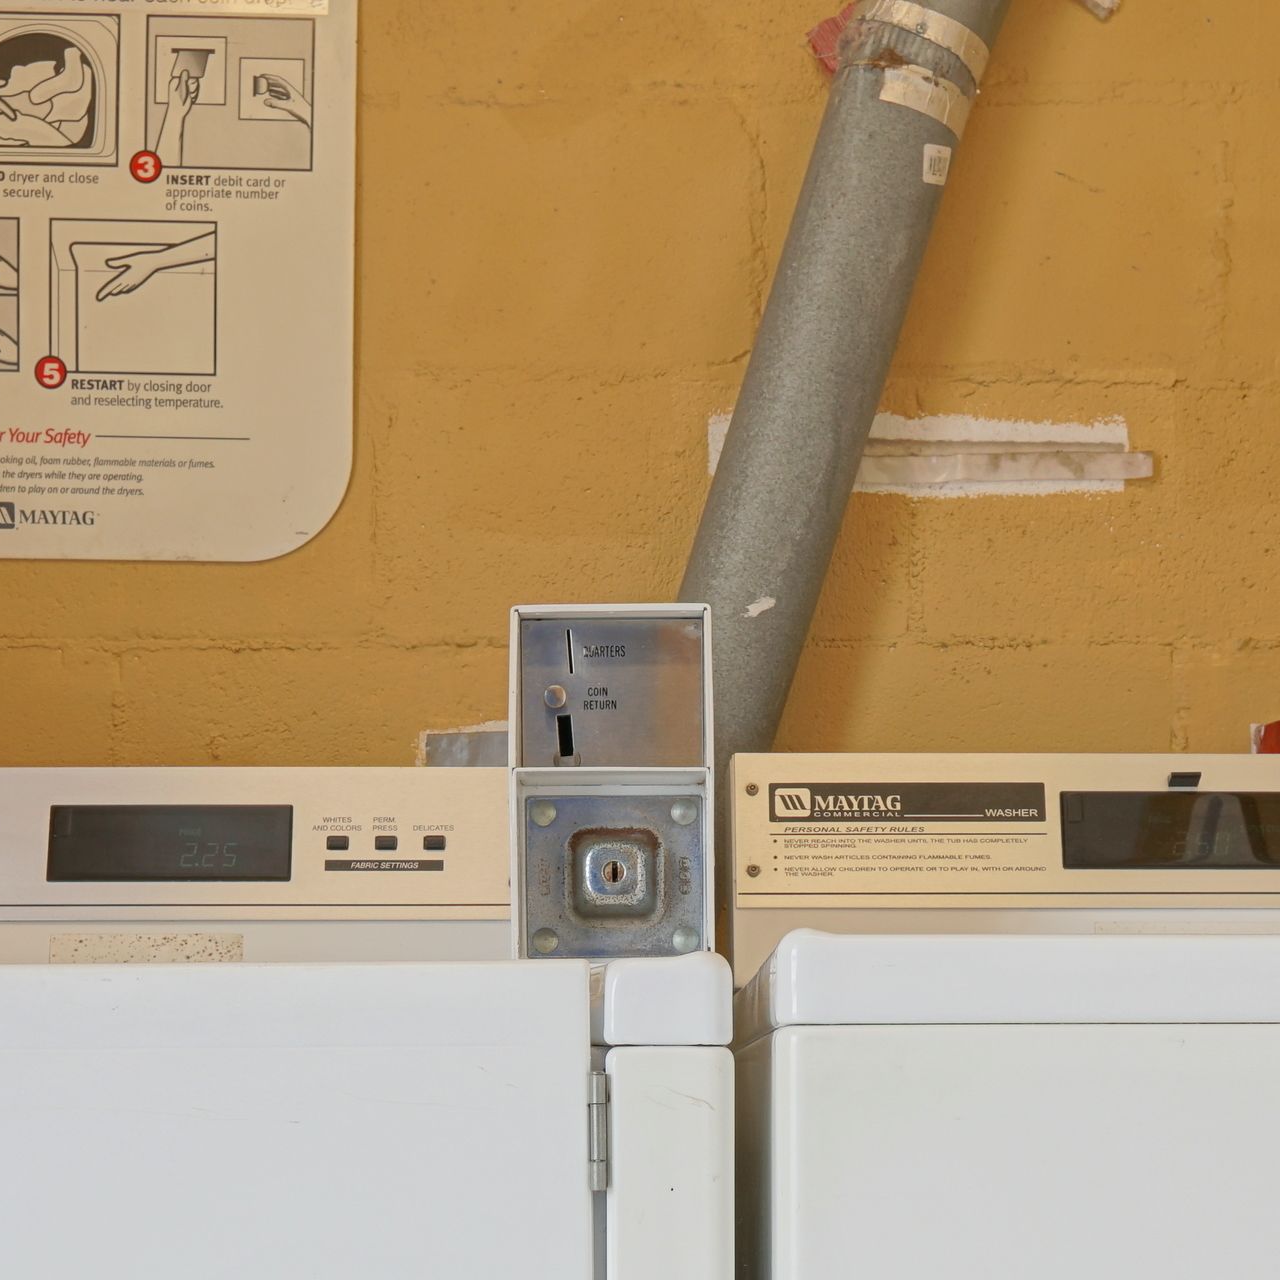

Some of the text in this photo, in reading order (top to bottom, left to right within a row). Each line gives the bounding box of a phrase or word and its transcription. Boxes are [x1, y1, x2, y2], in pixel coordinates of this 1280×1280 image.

[8, 171, 38, 185] dryer
[43, 172, 65, 183] and
[68, 172, 100, 184] close
[136, 156, 286, 188] 3 INSERT debit card or
[2, 186, 54, 200] securely.
[165, 188, 279, 202] appropriate number
[165, 200, 213, 212] of coins.
[42, 362, 211, 395] 5 RESTART by closing door
[70, 394, 224, 410] and reselecting temperature.
[8, 428, 42, 443] Your
[44, 428, 91, 449] Safety
[39, 456, 61, 466] foam
[93, 457, 137, 468] flammable
[138, 458, 176, 468] materials
[177, 460, 187, 468] or
[2, 469, 16, 478] the
[17, 470, 43, 480] dryers
[44, 471, 67, 480] while
[68, 472, 86, 482] they
[87, 473, 101, 481] are
[102, 472, 144, 483] operating.
[18, 484, 27, 493] to
[28, 485, 46, 495] play
[47, 486, 59, 494] on
[60, 486, 69, 494] or
[70, 486, 100, 495] around
[102, 486, 116, 495] the
[117, 486, 144, 497] dryers.
[19, 509, 95, 525] MAYTAG
[587, 687, 608, 697] COIN
[583, 700, 617, 711] RETURN
[814, 795, 901, 811] MAYTAG
[985, 809, 1038, 817] WASHER
[179, 842, 238, 868] 2.25
